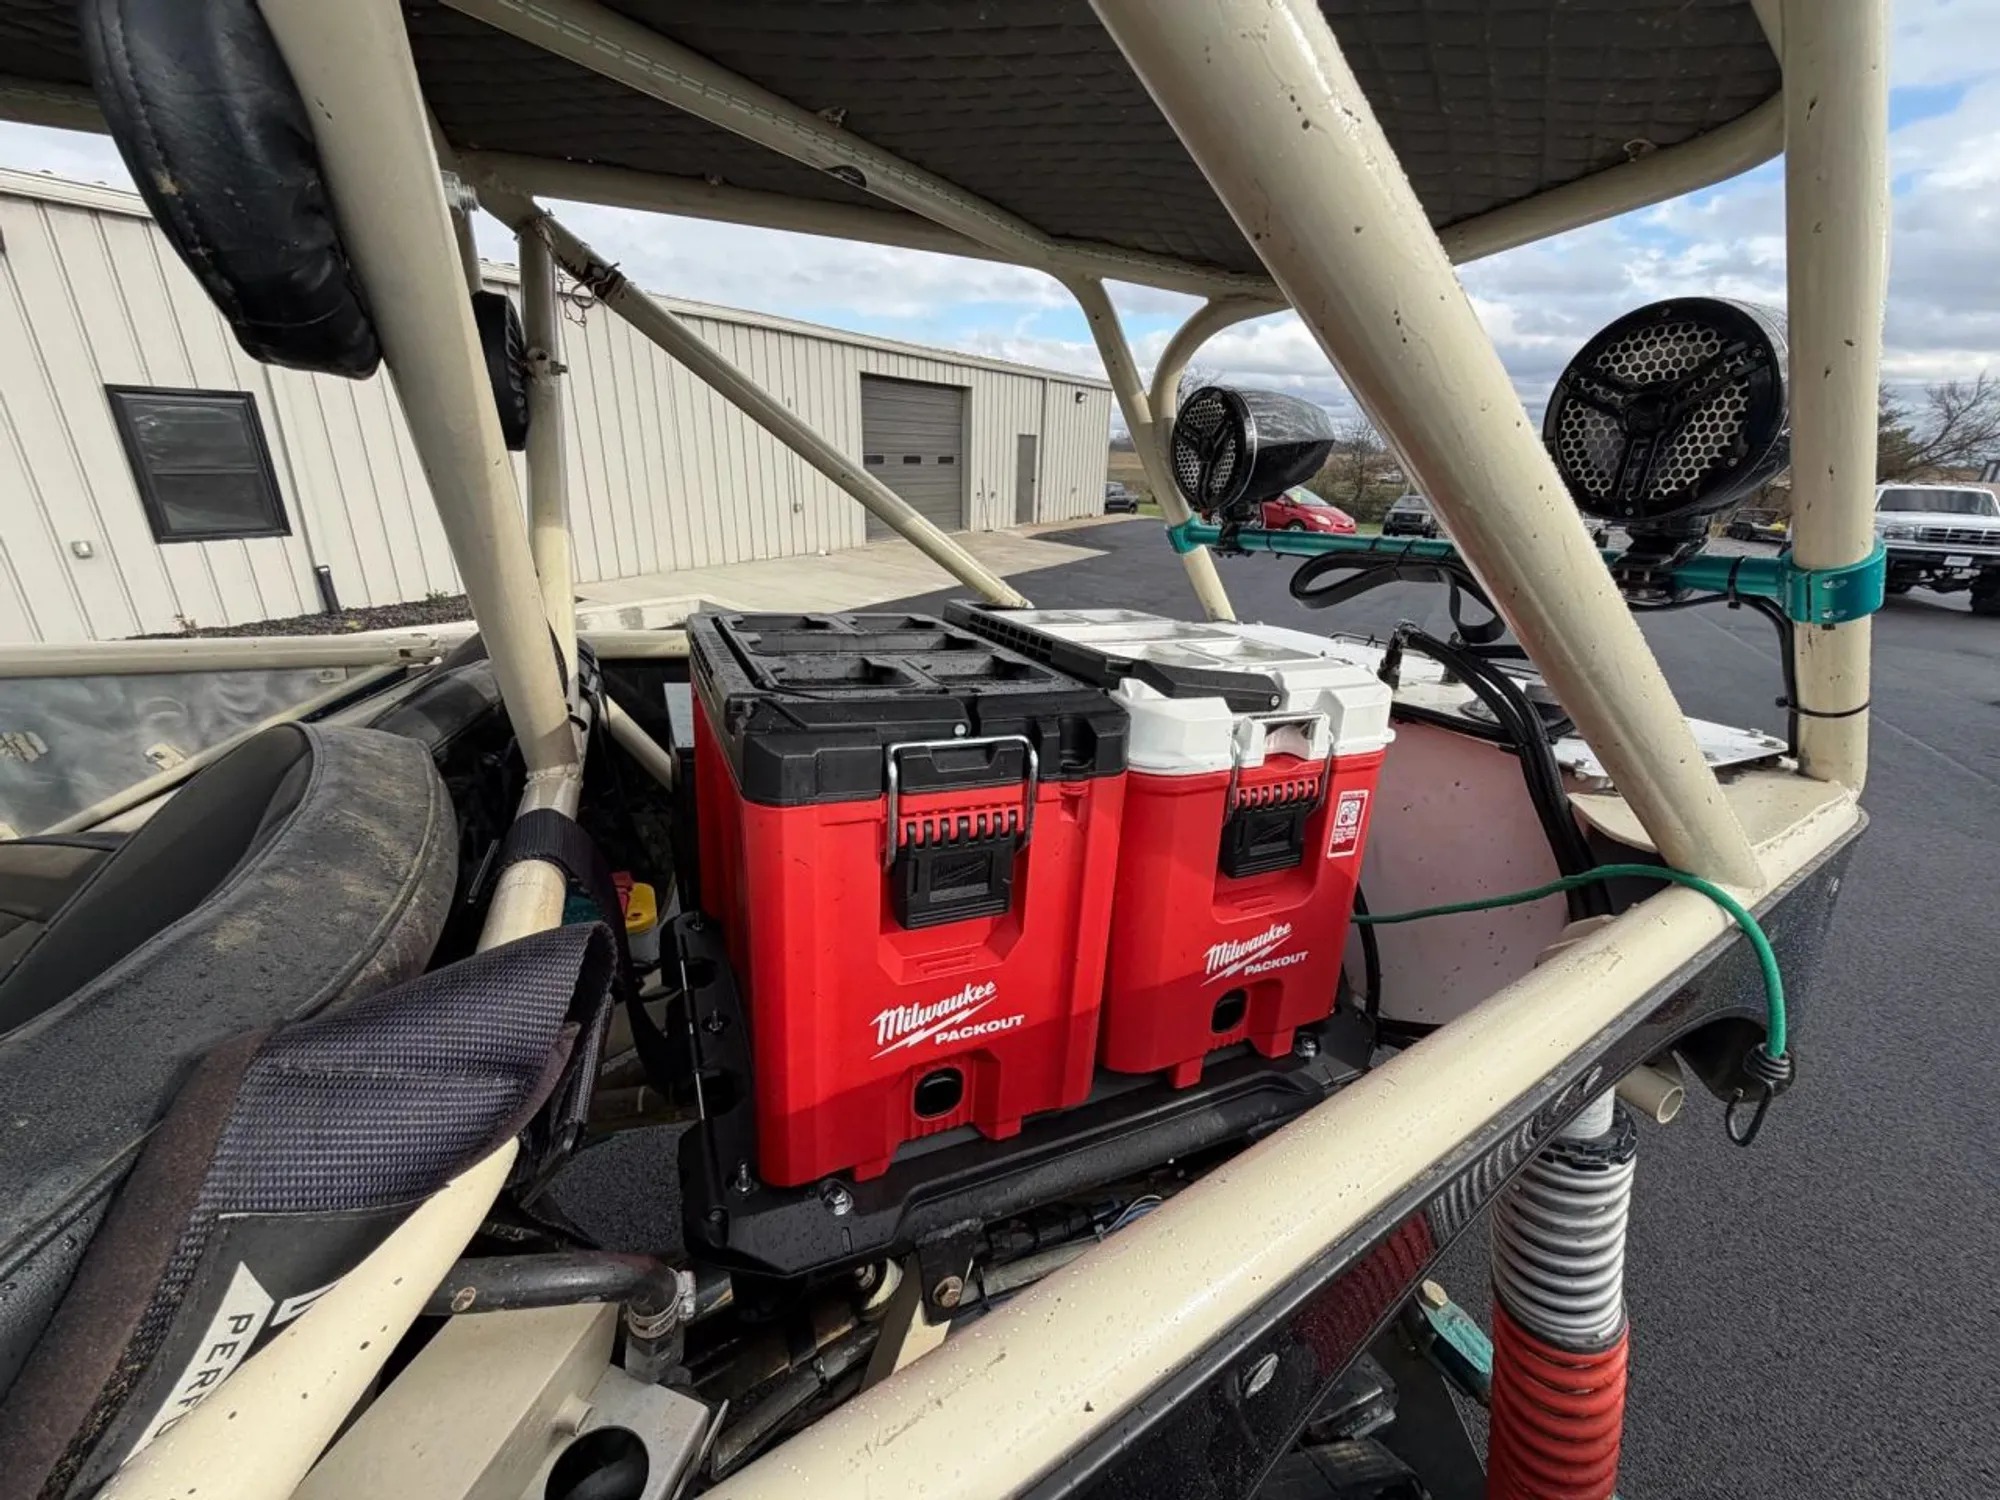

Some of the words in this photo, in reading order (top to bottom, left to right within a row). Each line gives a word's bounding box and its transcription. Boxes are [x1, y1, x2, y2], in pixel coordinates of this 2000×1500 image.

[1202, 922, 1292, 975] Milwaukee
[1244, 951, 1308, 976] PACKOUT
[869, 981, 997, 1045] Milwaukee
[934, 1014, 1025, 1044] PACKOUT
